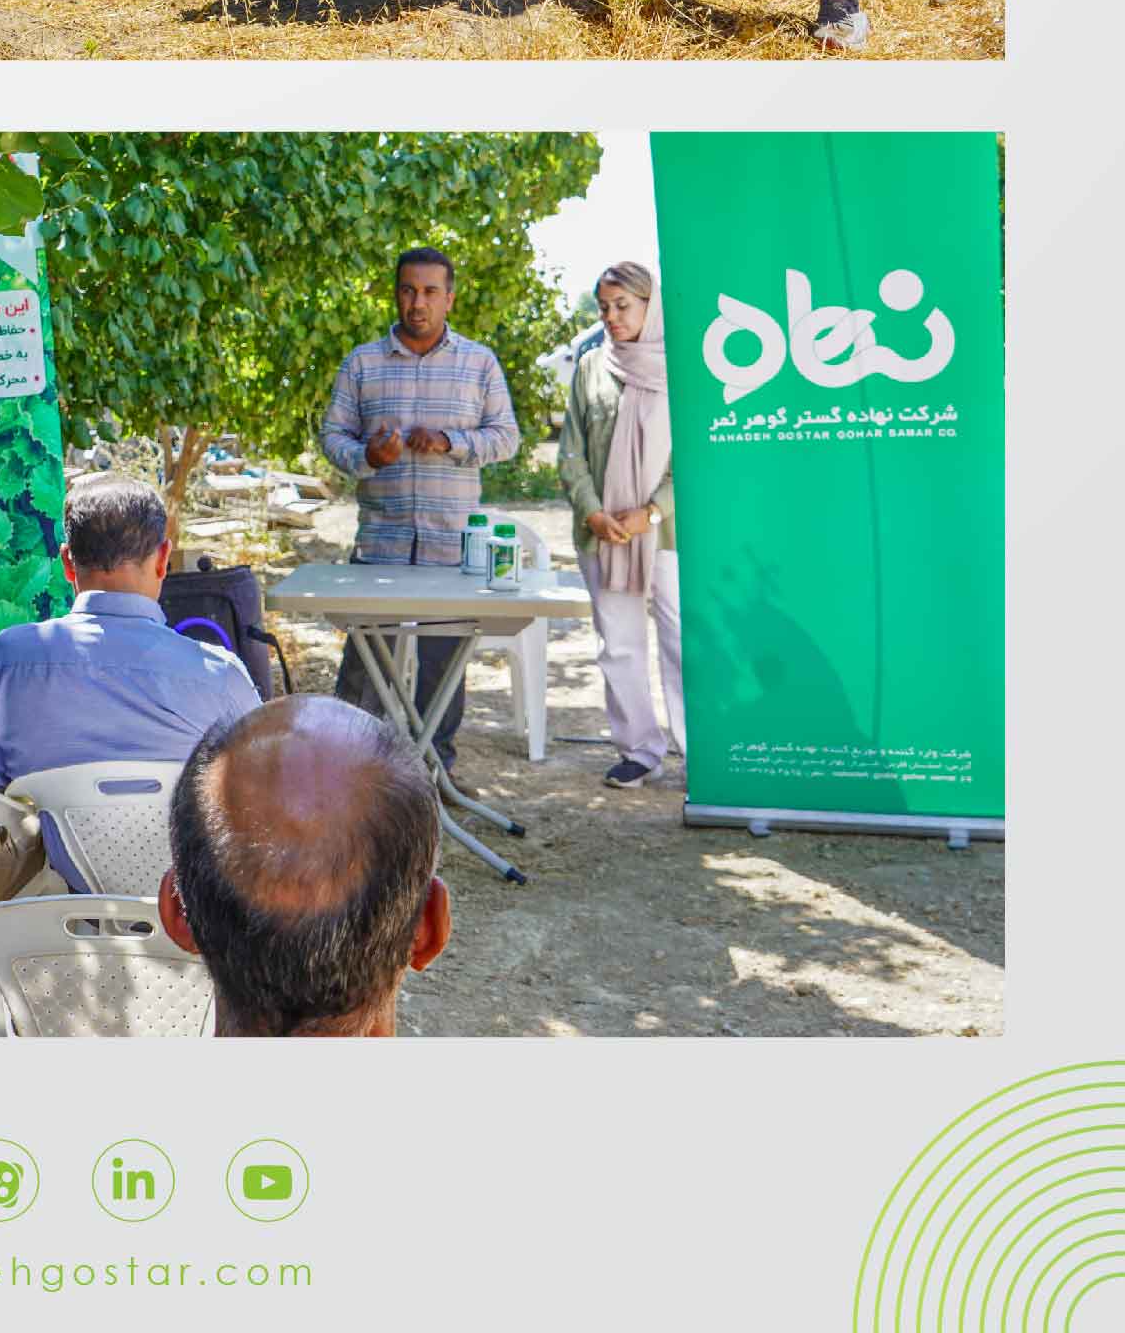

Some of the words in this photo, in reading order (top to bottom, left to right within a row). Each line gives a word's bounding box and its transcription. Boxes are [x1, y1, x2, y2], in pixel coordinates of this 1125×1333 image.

[5, 297, 30, 320] این
[16, 350, 28, 363] به
[709, 410, 737, 431] ثمر
[742, 406, 787, 430] گوهر
[793, 406, 842, 429] گستر
[847, 406, 893, 427] نهاده
[898, 403, 958, 426] شرکت
[709, 431, 771, 444] NAHADEH
[777, 430, 830, 442] GOSTAR
[836, 429, 883, 440] GOHAR
[888, 427, 933, 438] SAMAR
